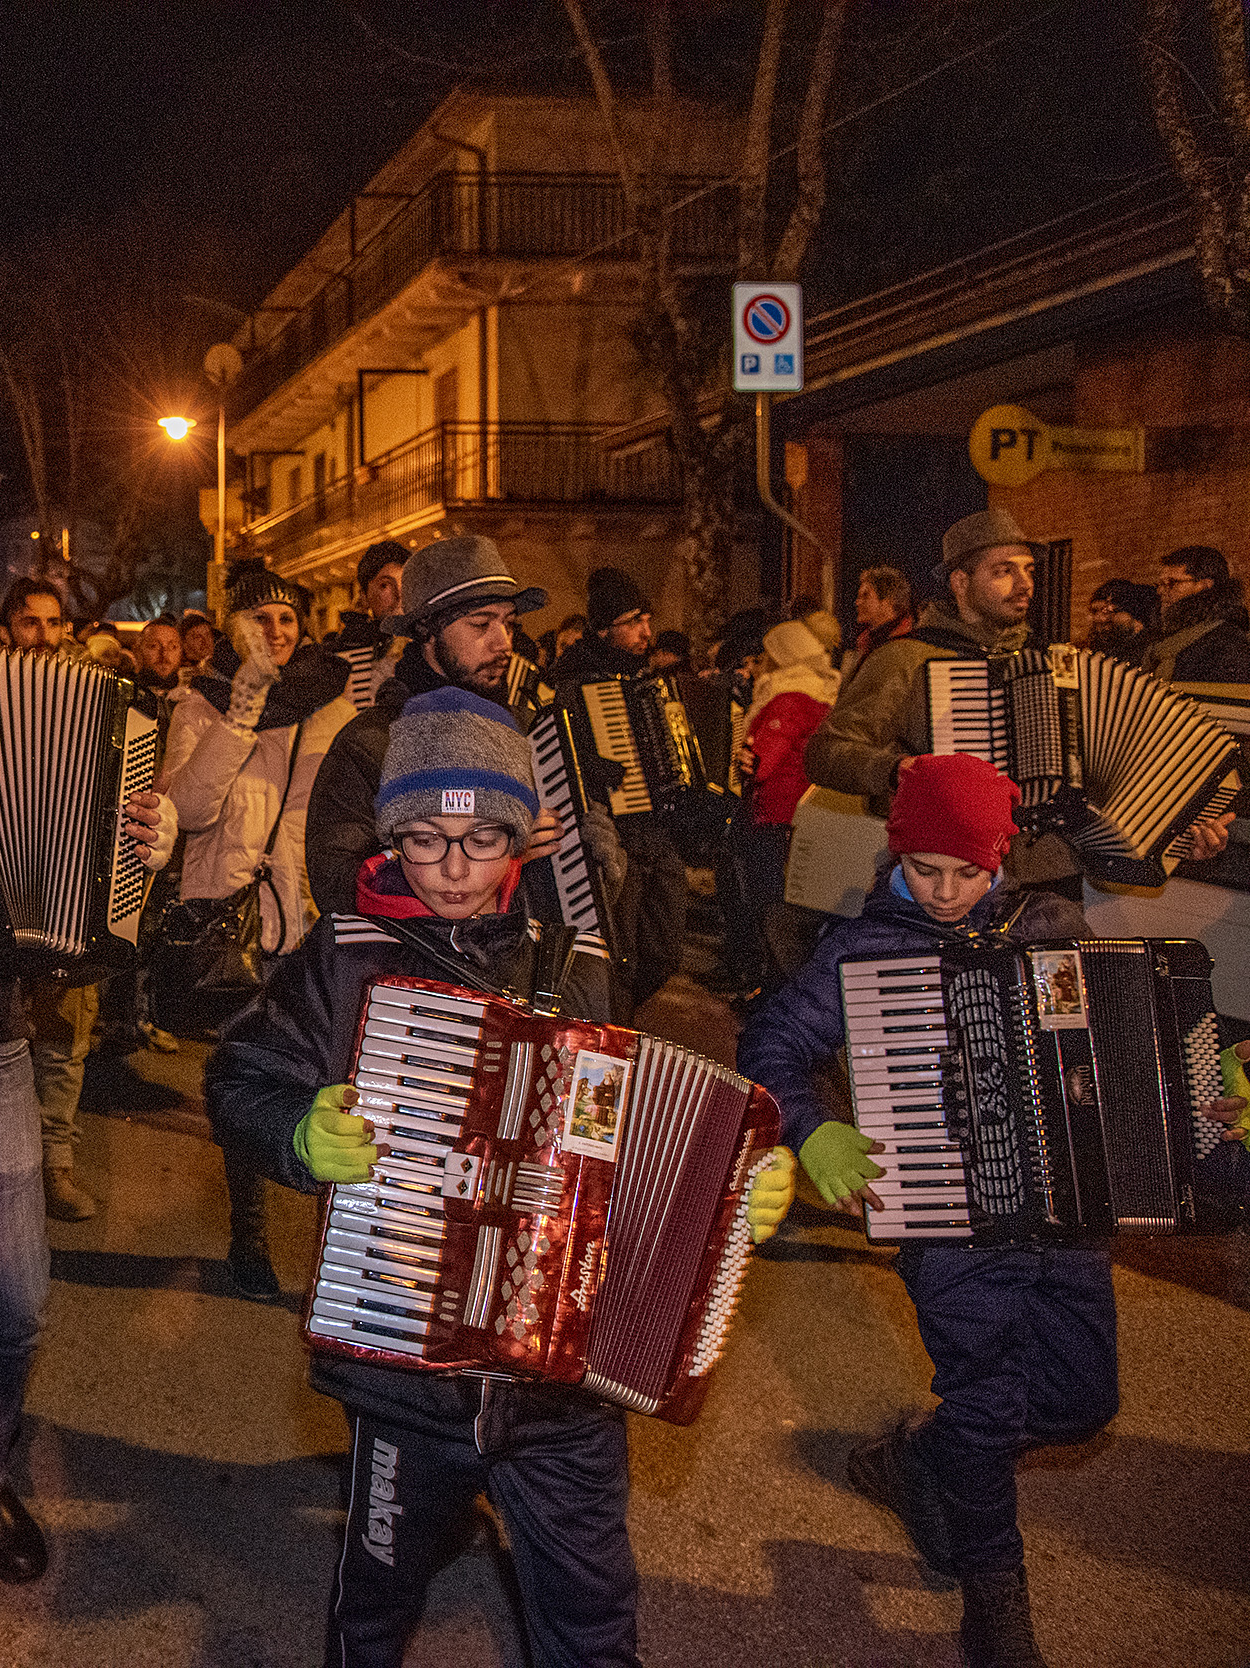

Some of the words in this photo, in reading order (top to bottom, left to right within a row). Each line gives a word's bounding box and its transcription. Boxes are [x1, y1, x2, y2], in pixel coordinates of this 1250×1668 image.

[743, 355, 758, 374] P
[991, 428, 1042, 461] PT
[445, 792, 471, 807] NYC
[570, 1240, 595, 1312] Ariston
[362, 1437, 404, 1567] makay
